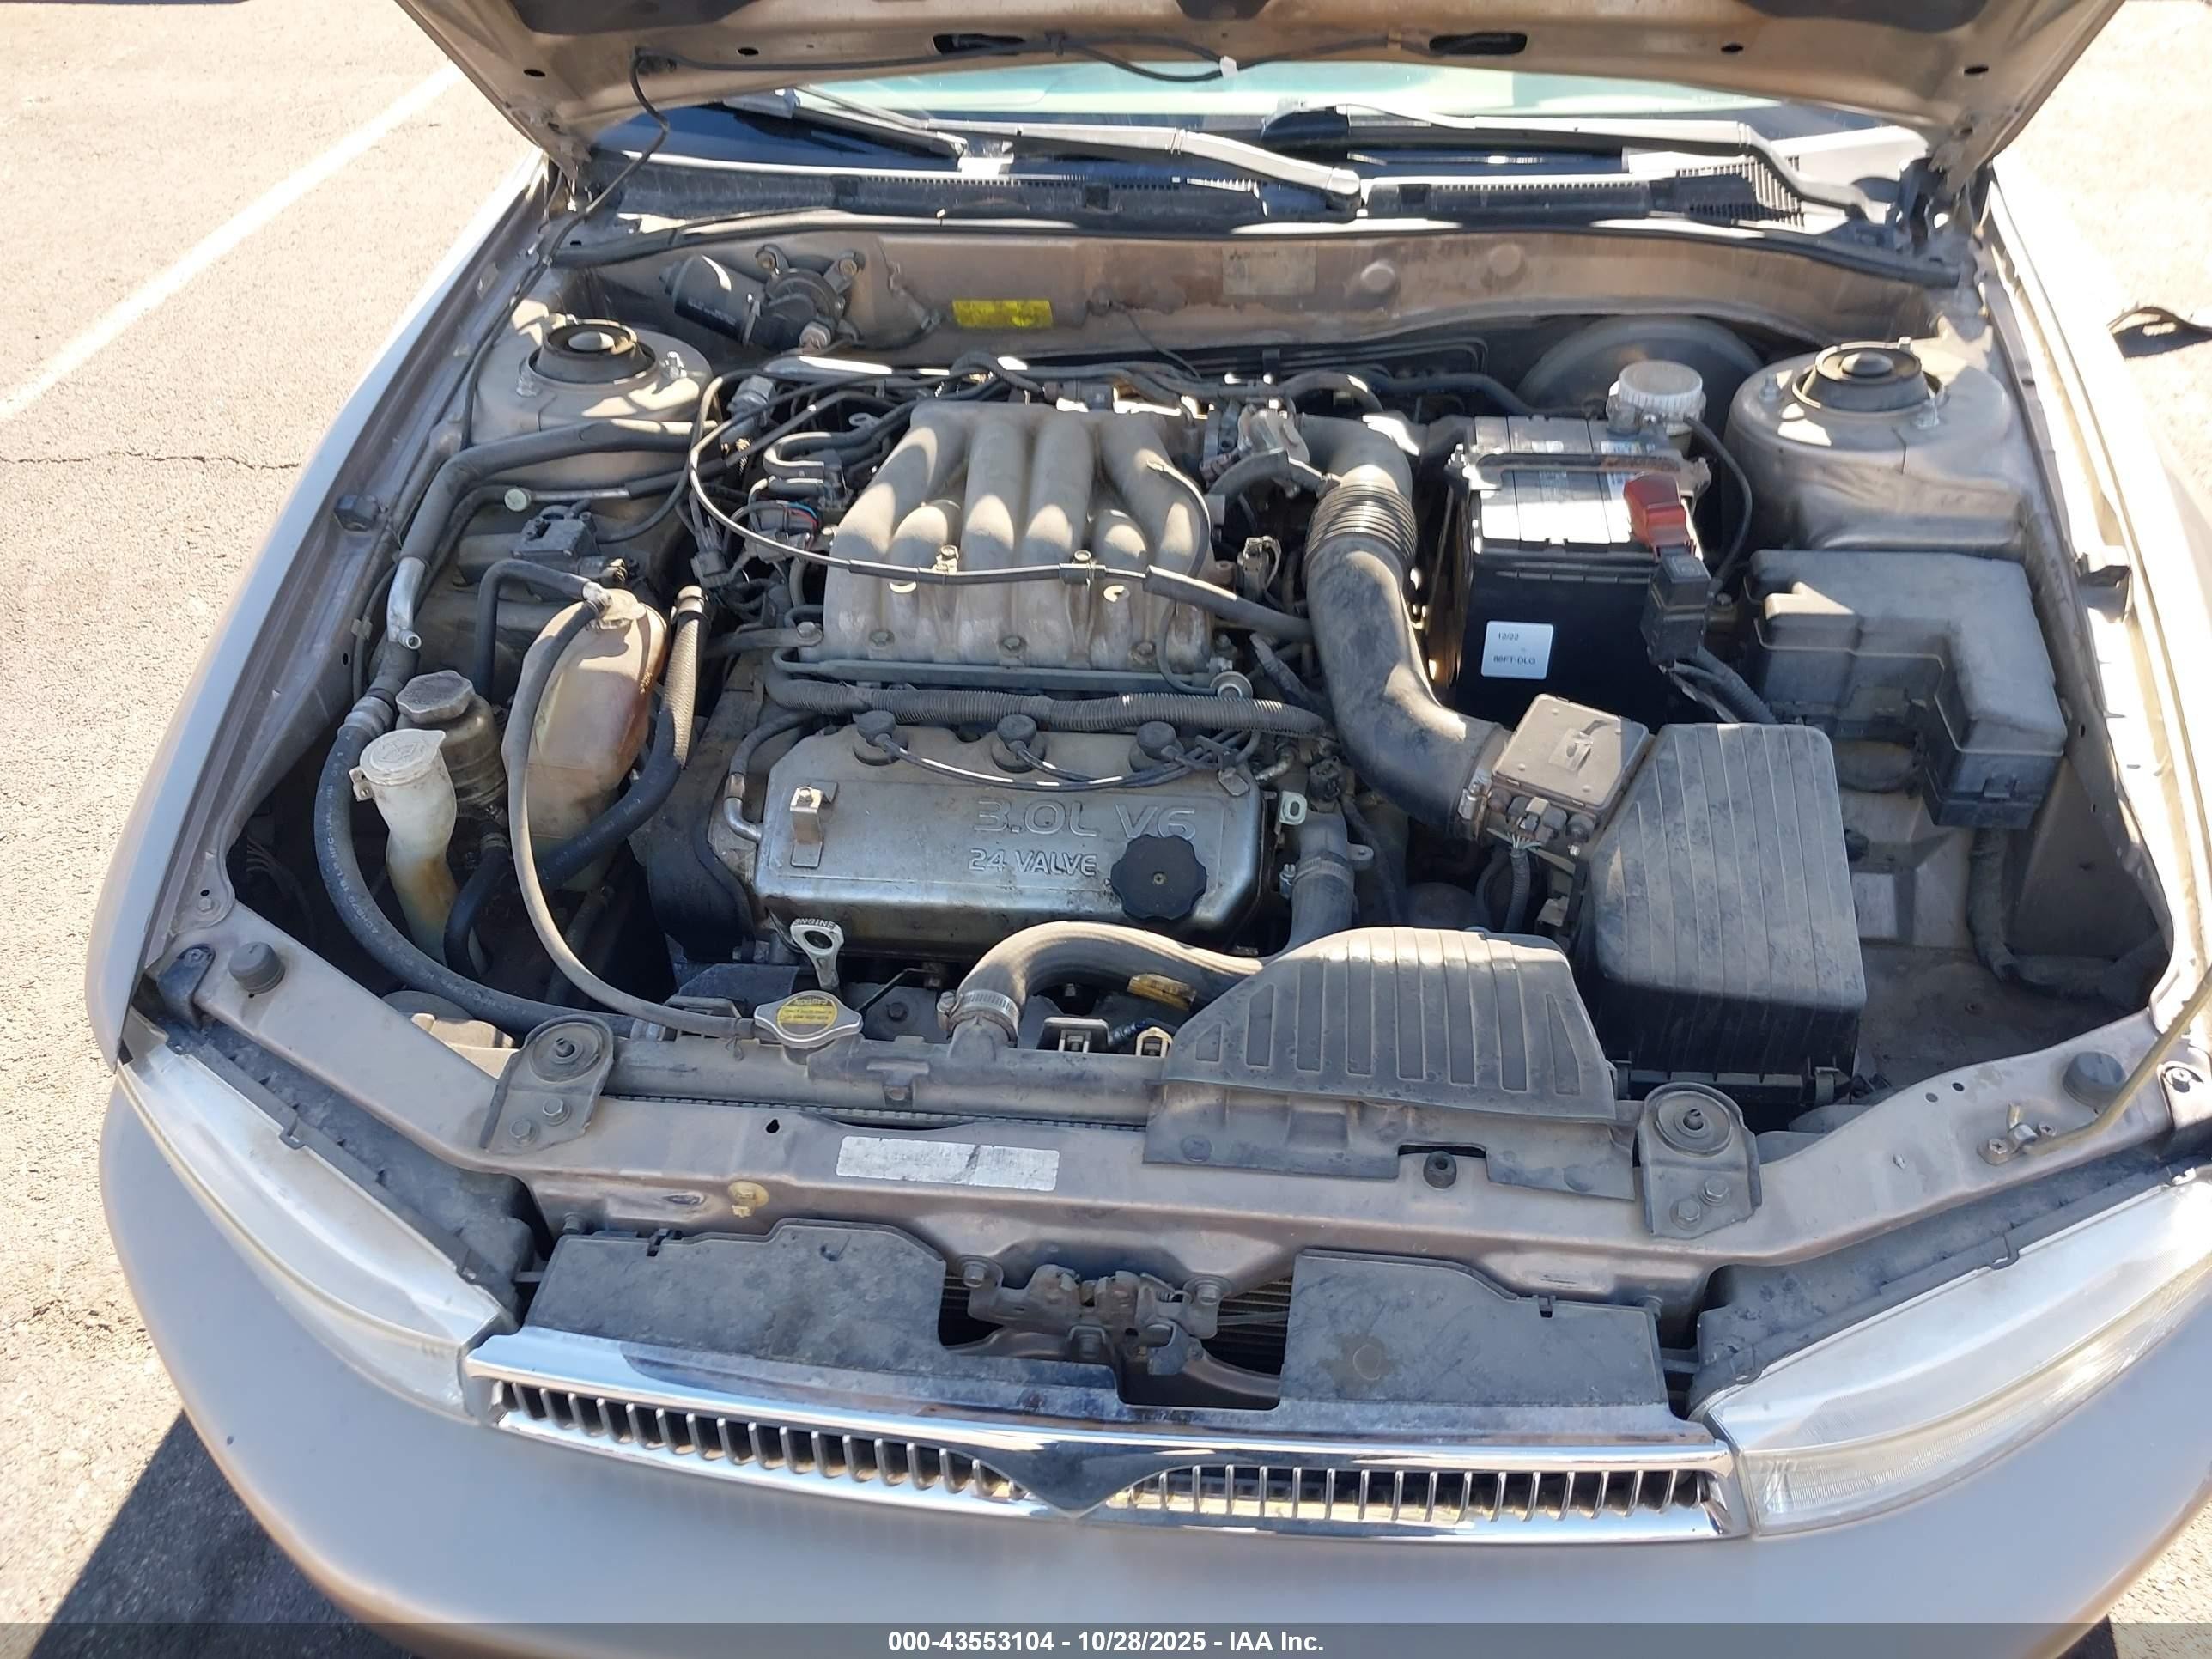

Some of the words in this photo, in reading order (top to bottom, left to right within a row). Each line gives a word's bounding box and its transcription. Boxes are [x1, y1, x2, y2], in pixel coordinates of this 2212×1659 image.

[974, 799, 1097, 837] 3.0L
[1115, 803, 1196, 841] V6
[968, 848, 1006, 872] 24
[1014, 849, 1097, 876] VALVE
[793, 918, 836, 929] ENGINE
